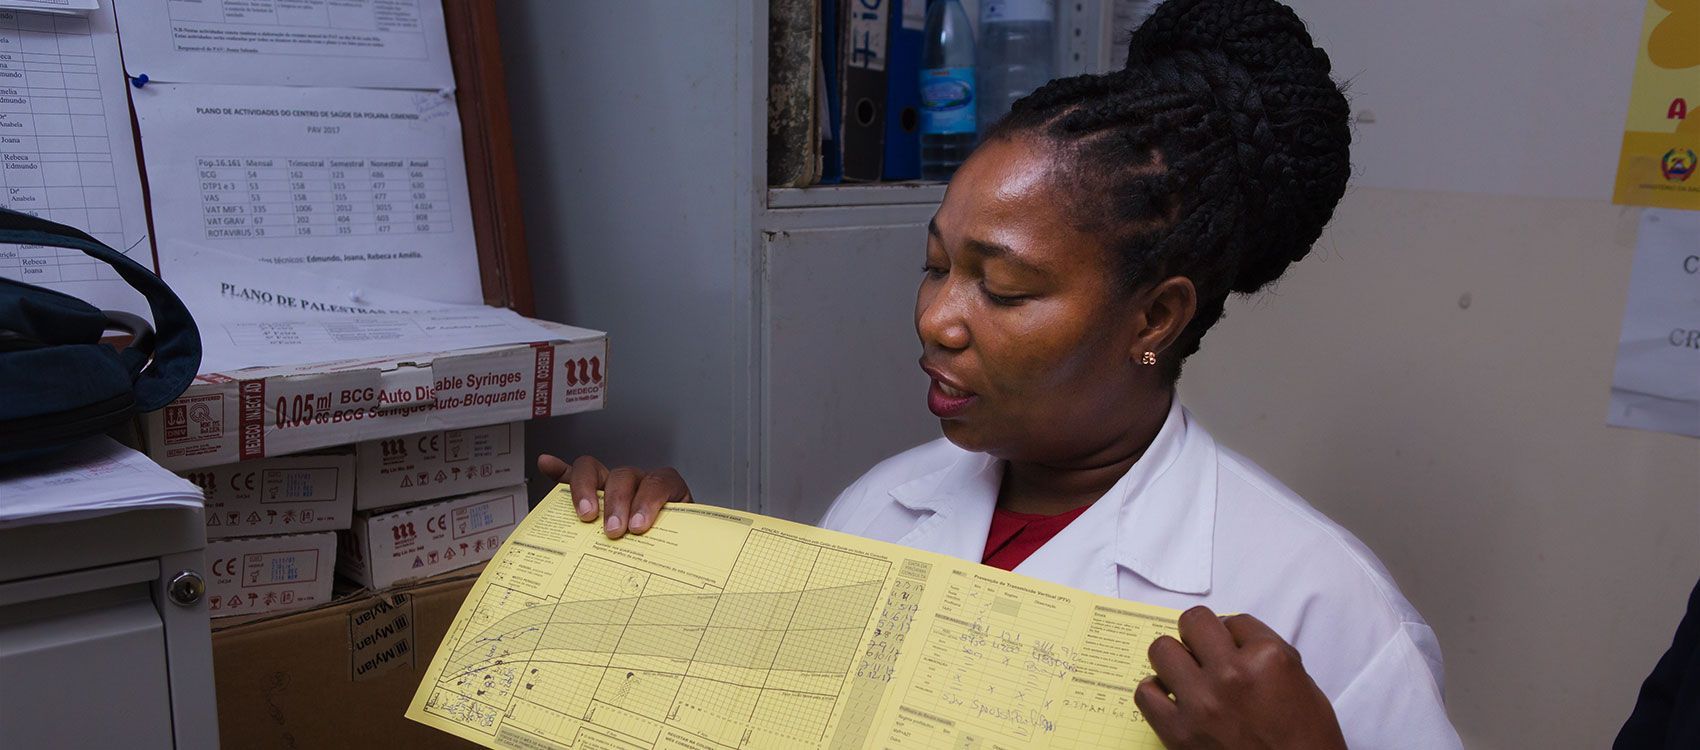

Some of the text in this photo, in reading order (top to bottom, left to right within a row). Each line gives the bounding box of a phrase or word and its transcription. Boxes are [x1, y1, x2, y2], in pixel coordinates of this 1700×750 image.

[196, 107, 221, 115] PLANO
[234, 108, 279, 116] ACTIVIDADES
[281, 109, 291, 117] DO
[320, 110, 329, 118] DE
[1667, 98, 1687, 119] A
[307, 126, 321, 134] PAV
[330, 160, 364, 168] Semestral
[200, 171, 217, 179] BCG
[204, 194, 220, 202] VAS
[205, 205, 221, 213] VAT
[207, 217, 223, 225] VAT
[224, 217, 245, 225] GRAV
[208, 229, 252, 237] ROTAVIRUS
[367, 252, 391, 260] Rebeca
[220, 281, 273, 303] PLANO
[276, 294, 297, 308] DE
[536, 351, 549, 379] MEDECO
[275, 394, 314, 429] 0.05
[316, 392, 332, 410] ml
[340, 387, 374, 404] BCG
[378, 388, 412, 404] Auto
[466, 371, 522, 390] Syringes
[566, 387, 598, 396] MEDECO
[332, 408, 364, 424] BCG
[430, 388, 527, 412] Auto-Bloquante
[246, 424, 261, 455] MEDECO
[418, 434, 439, 453] CE
[230, 472, 256, 491] CE
[427, 513, 447, 533] CE
[212, 558, 237, 577] CE
[1006, 581, 1036, 595] Transmissão
[1037, 589, 1057, 600] Vertical
[355, 600, 393, 626] Mylan
[356, 623, 395, 651] Mylan
[357, 648, 396, 675] Mylan
